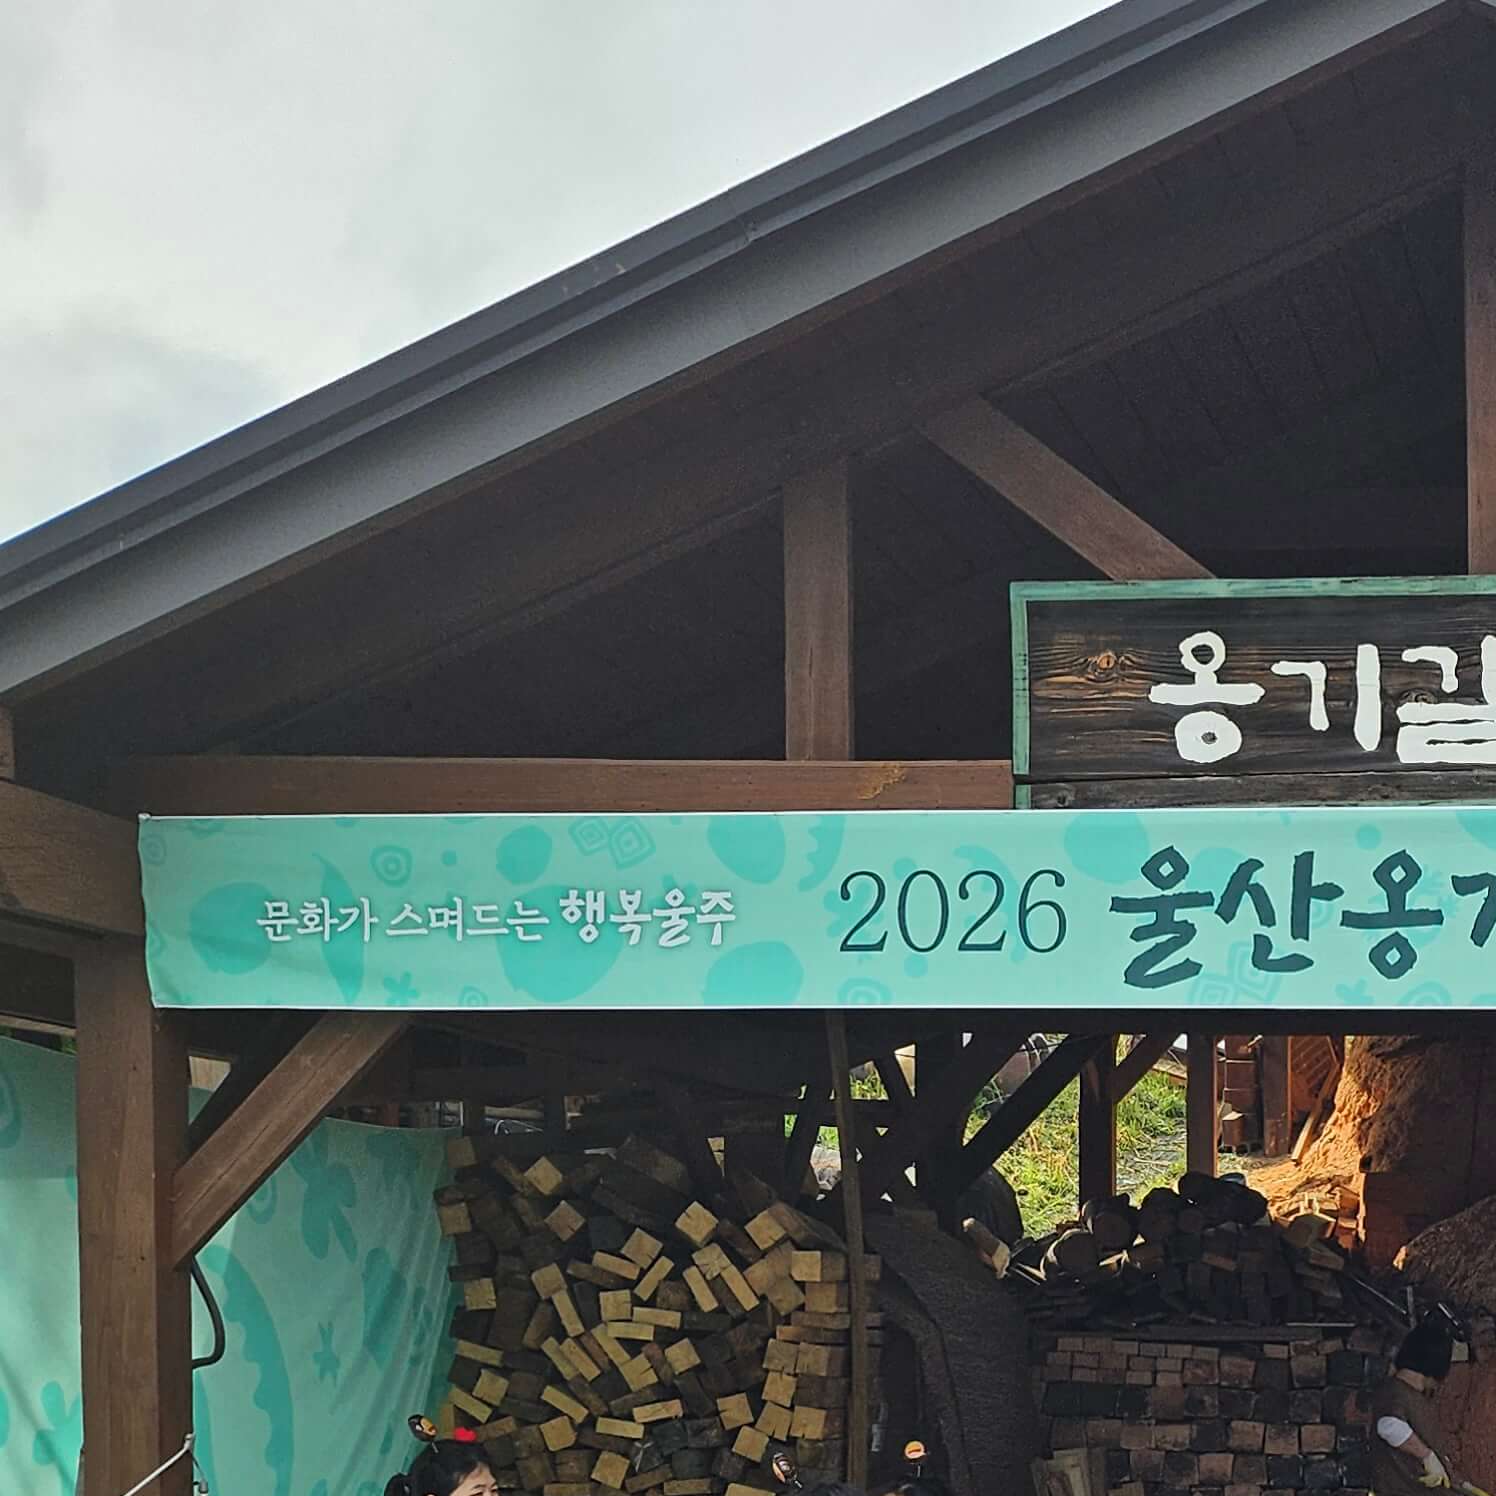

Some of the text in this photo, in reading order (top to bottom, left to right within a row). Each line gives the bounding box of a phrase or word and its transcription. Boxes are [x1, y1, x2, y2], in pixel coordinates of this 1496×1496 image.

[257, 888, 736, 947] 문화가 스며드는 행복울주
[839, 869, 1067, 953] 2026
